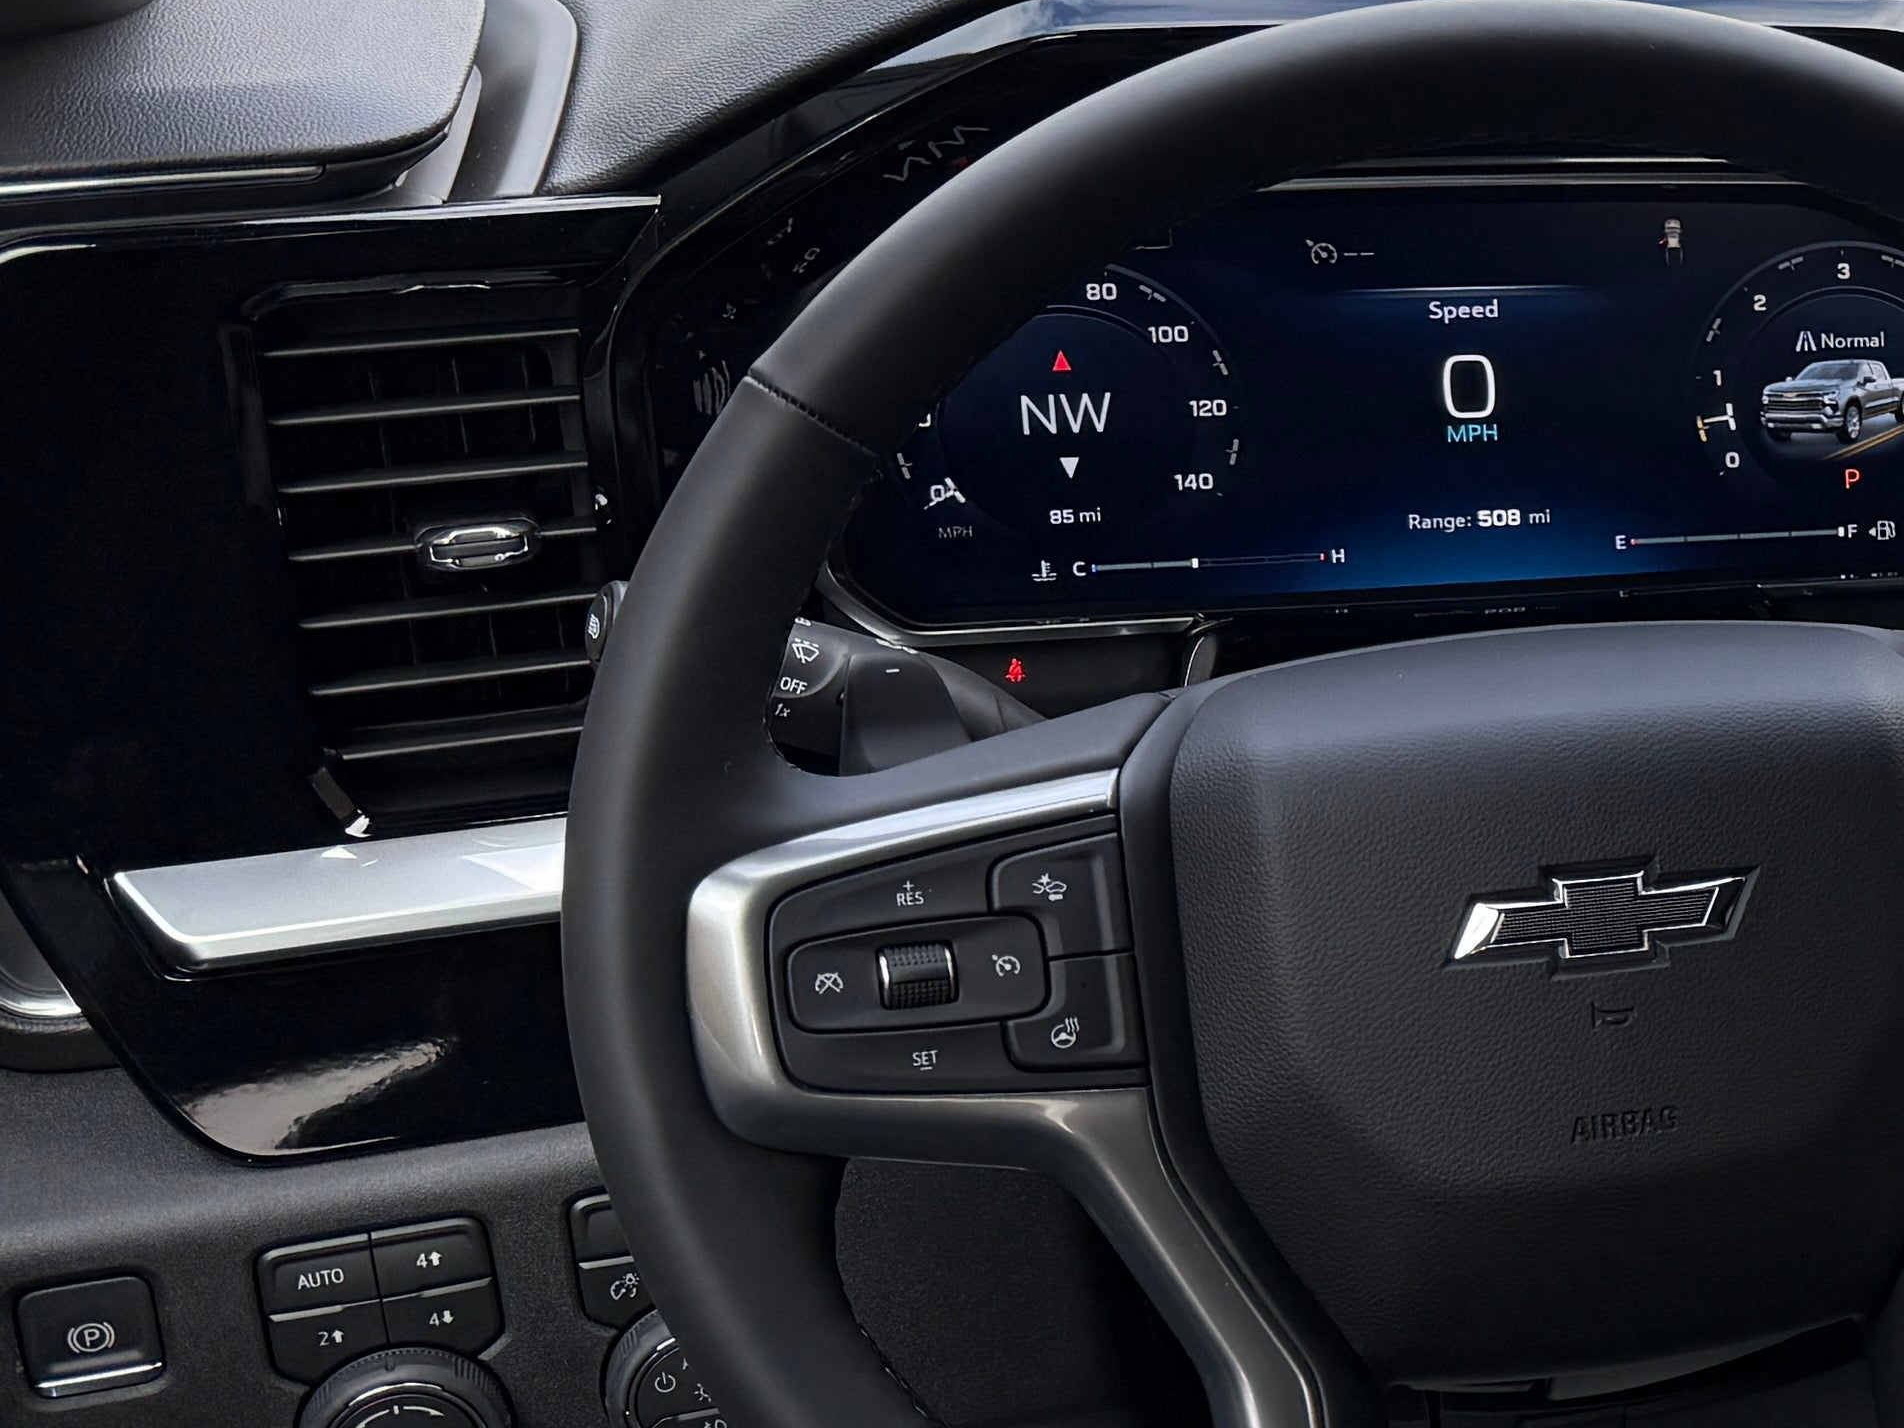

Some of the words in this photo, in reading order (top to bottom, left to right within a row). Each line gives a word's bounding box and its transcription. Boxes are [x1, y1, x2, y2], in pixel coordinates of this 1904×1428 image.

[1836, 263, 1850, 280] 3
[1086, 283, 1118, 301] 80
[1428, 299, 1499, 322] Speed
[1753, 295, 1767, 312] 2
[1147, 325, 1189, 344] 100
[1820, 331, 1885, 350] Normal
[1442, 354, 1496, 419] 0
[1712, 370, 1722, 387] 1
[1020, 391, 1111, 436] NW
[1189, 399, 1227, 417] 120
[1446, 424, 1499, 443] MPH
[1725, 452, 1740, 469] 0
[1174, 472, 1214, 491] 140
[1845, 468, 1860, 489] P
[1049, 508, 1075, 525] 85
[1078, 506, 1102, 524] mi
[1408, 512, 1472, 532] Range:
[1476, 508, 1521, 527] 508
[1528, 508, 1551, 525] mi
[938, 525, 973, 539] MPH
[1847, 524, 1858, 539] F
[1615, 535, 1627, 550] E
[1331, 549, 1345, 564] H
[1072, 561, 1086, 576] C
[780, 676, 808, 695] OFF
[774, 703, 791, 718] 1x
[896, 890, 925, 907] RES
[912, 1050, 939, 1066] SET
[1571, 1105, 1677, 1143] AIRBAG
[416, 1253, 428, 1268] 4
[297, 1267, 345, 1290] AUTO
[428, 1312, 440, 1327] 4
[318, 1331, 332, 1346] 2
